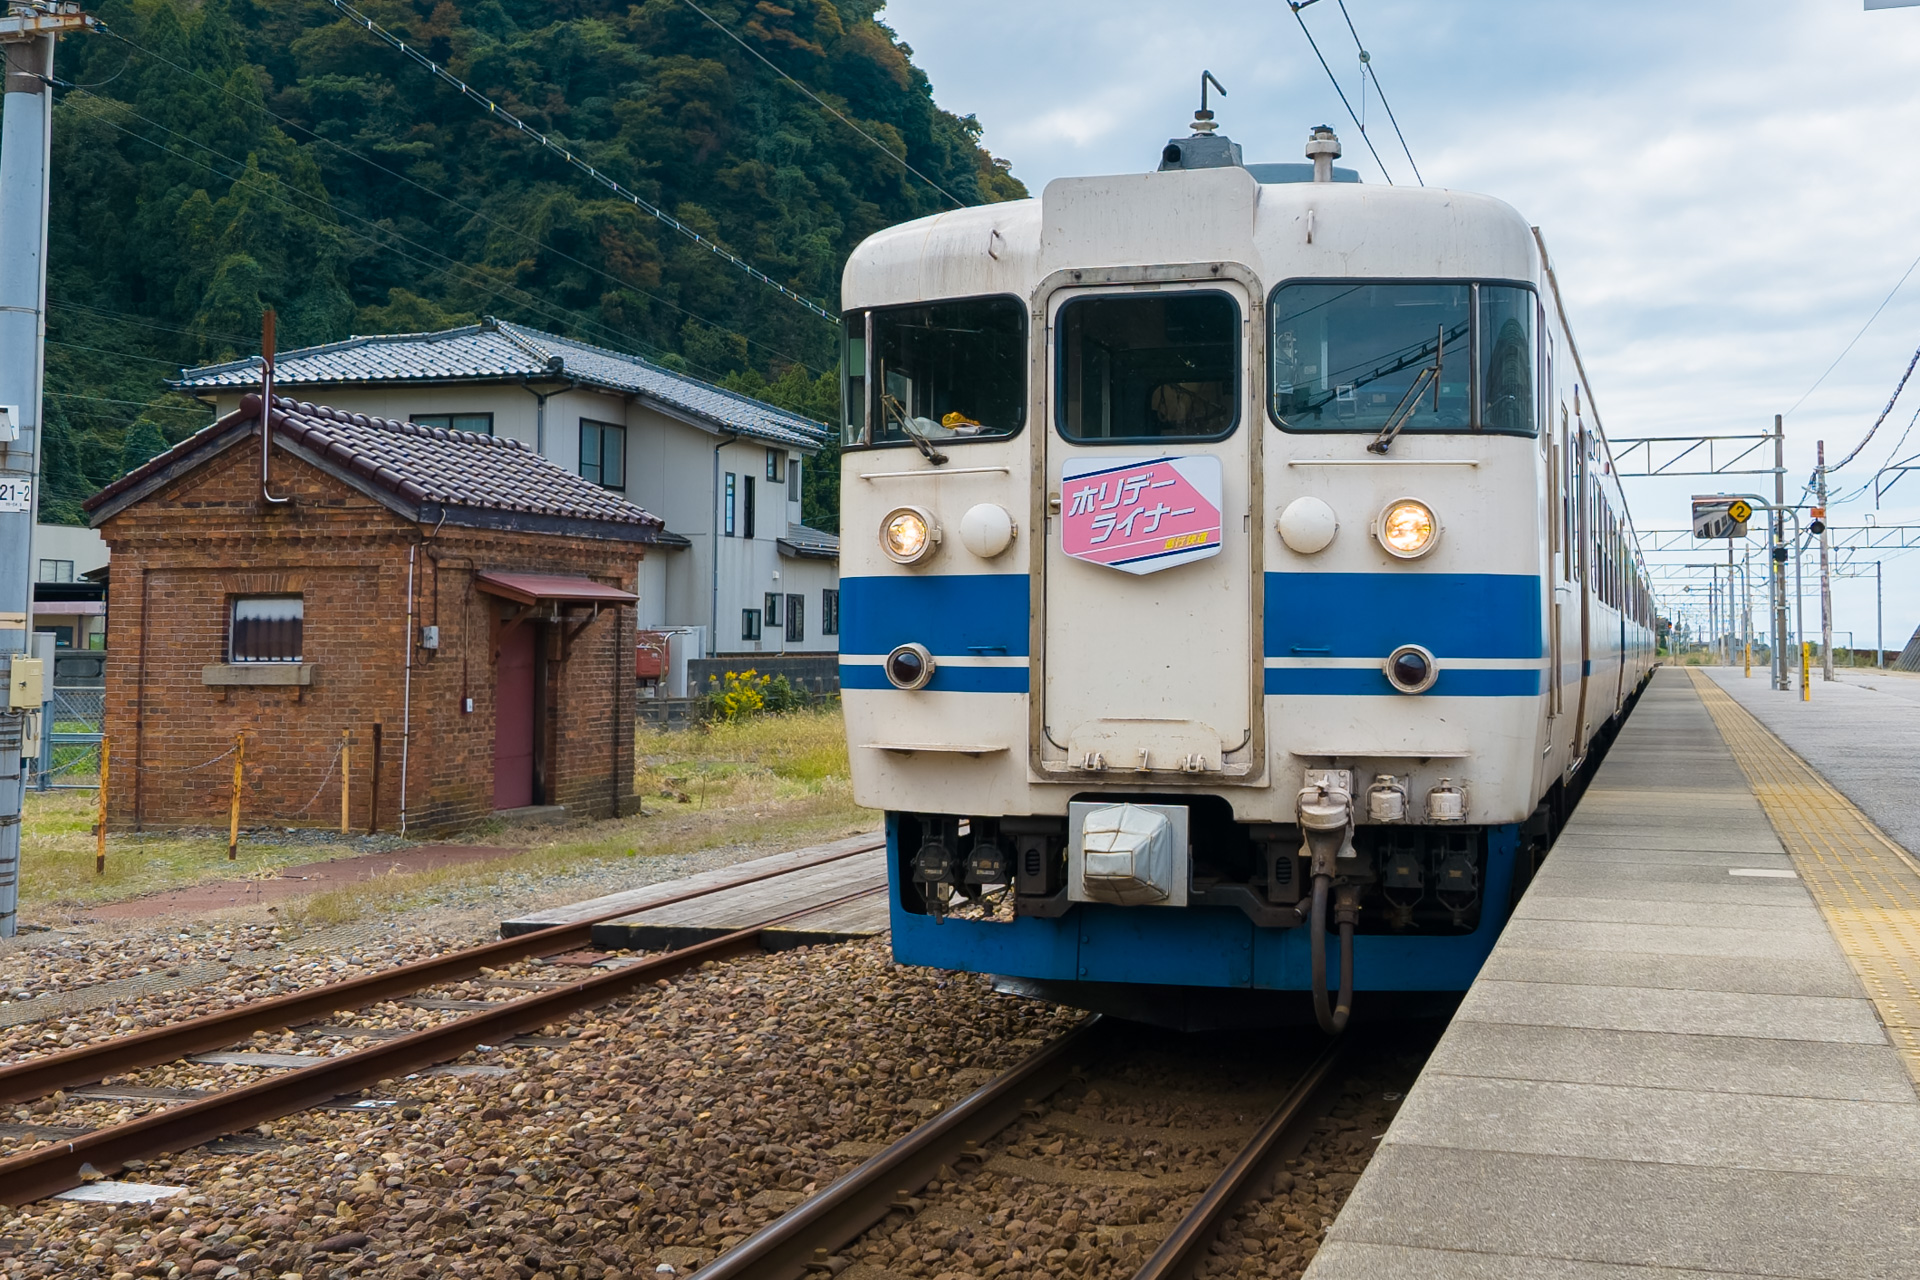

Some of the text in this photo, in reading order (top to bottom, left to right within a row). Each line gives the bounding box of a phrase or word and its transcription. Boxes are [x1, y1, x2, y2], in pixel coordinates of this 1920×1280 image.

[1069, 472, 1176, 517] ホリデー
[1736, 506, 1745, 517] 2
[1089, 502, 1195, 544] ライナー
